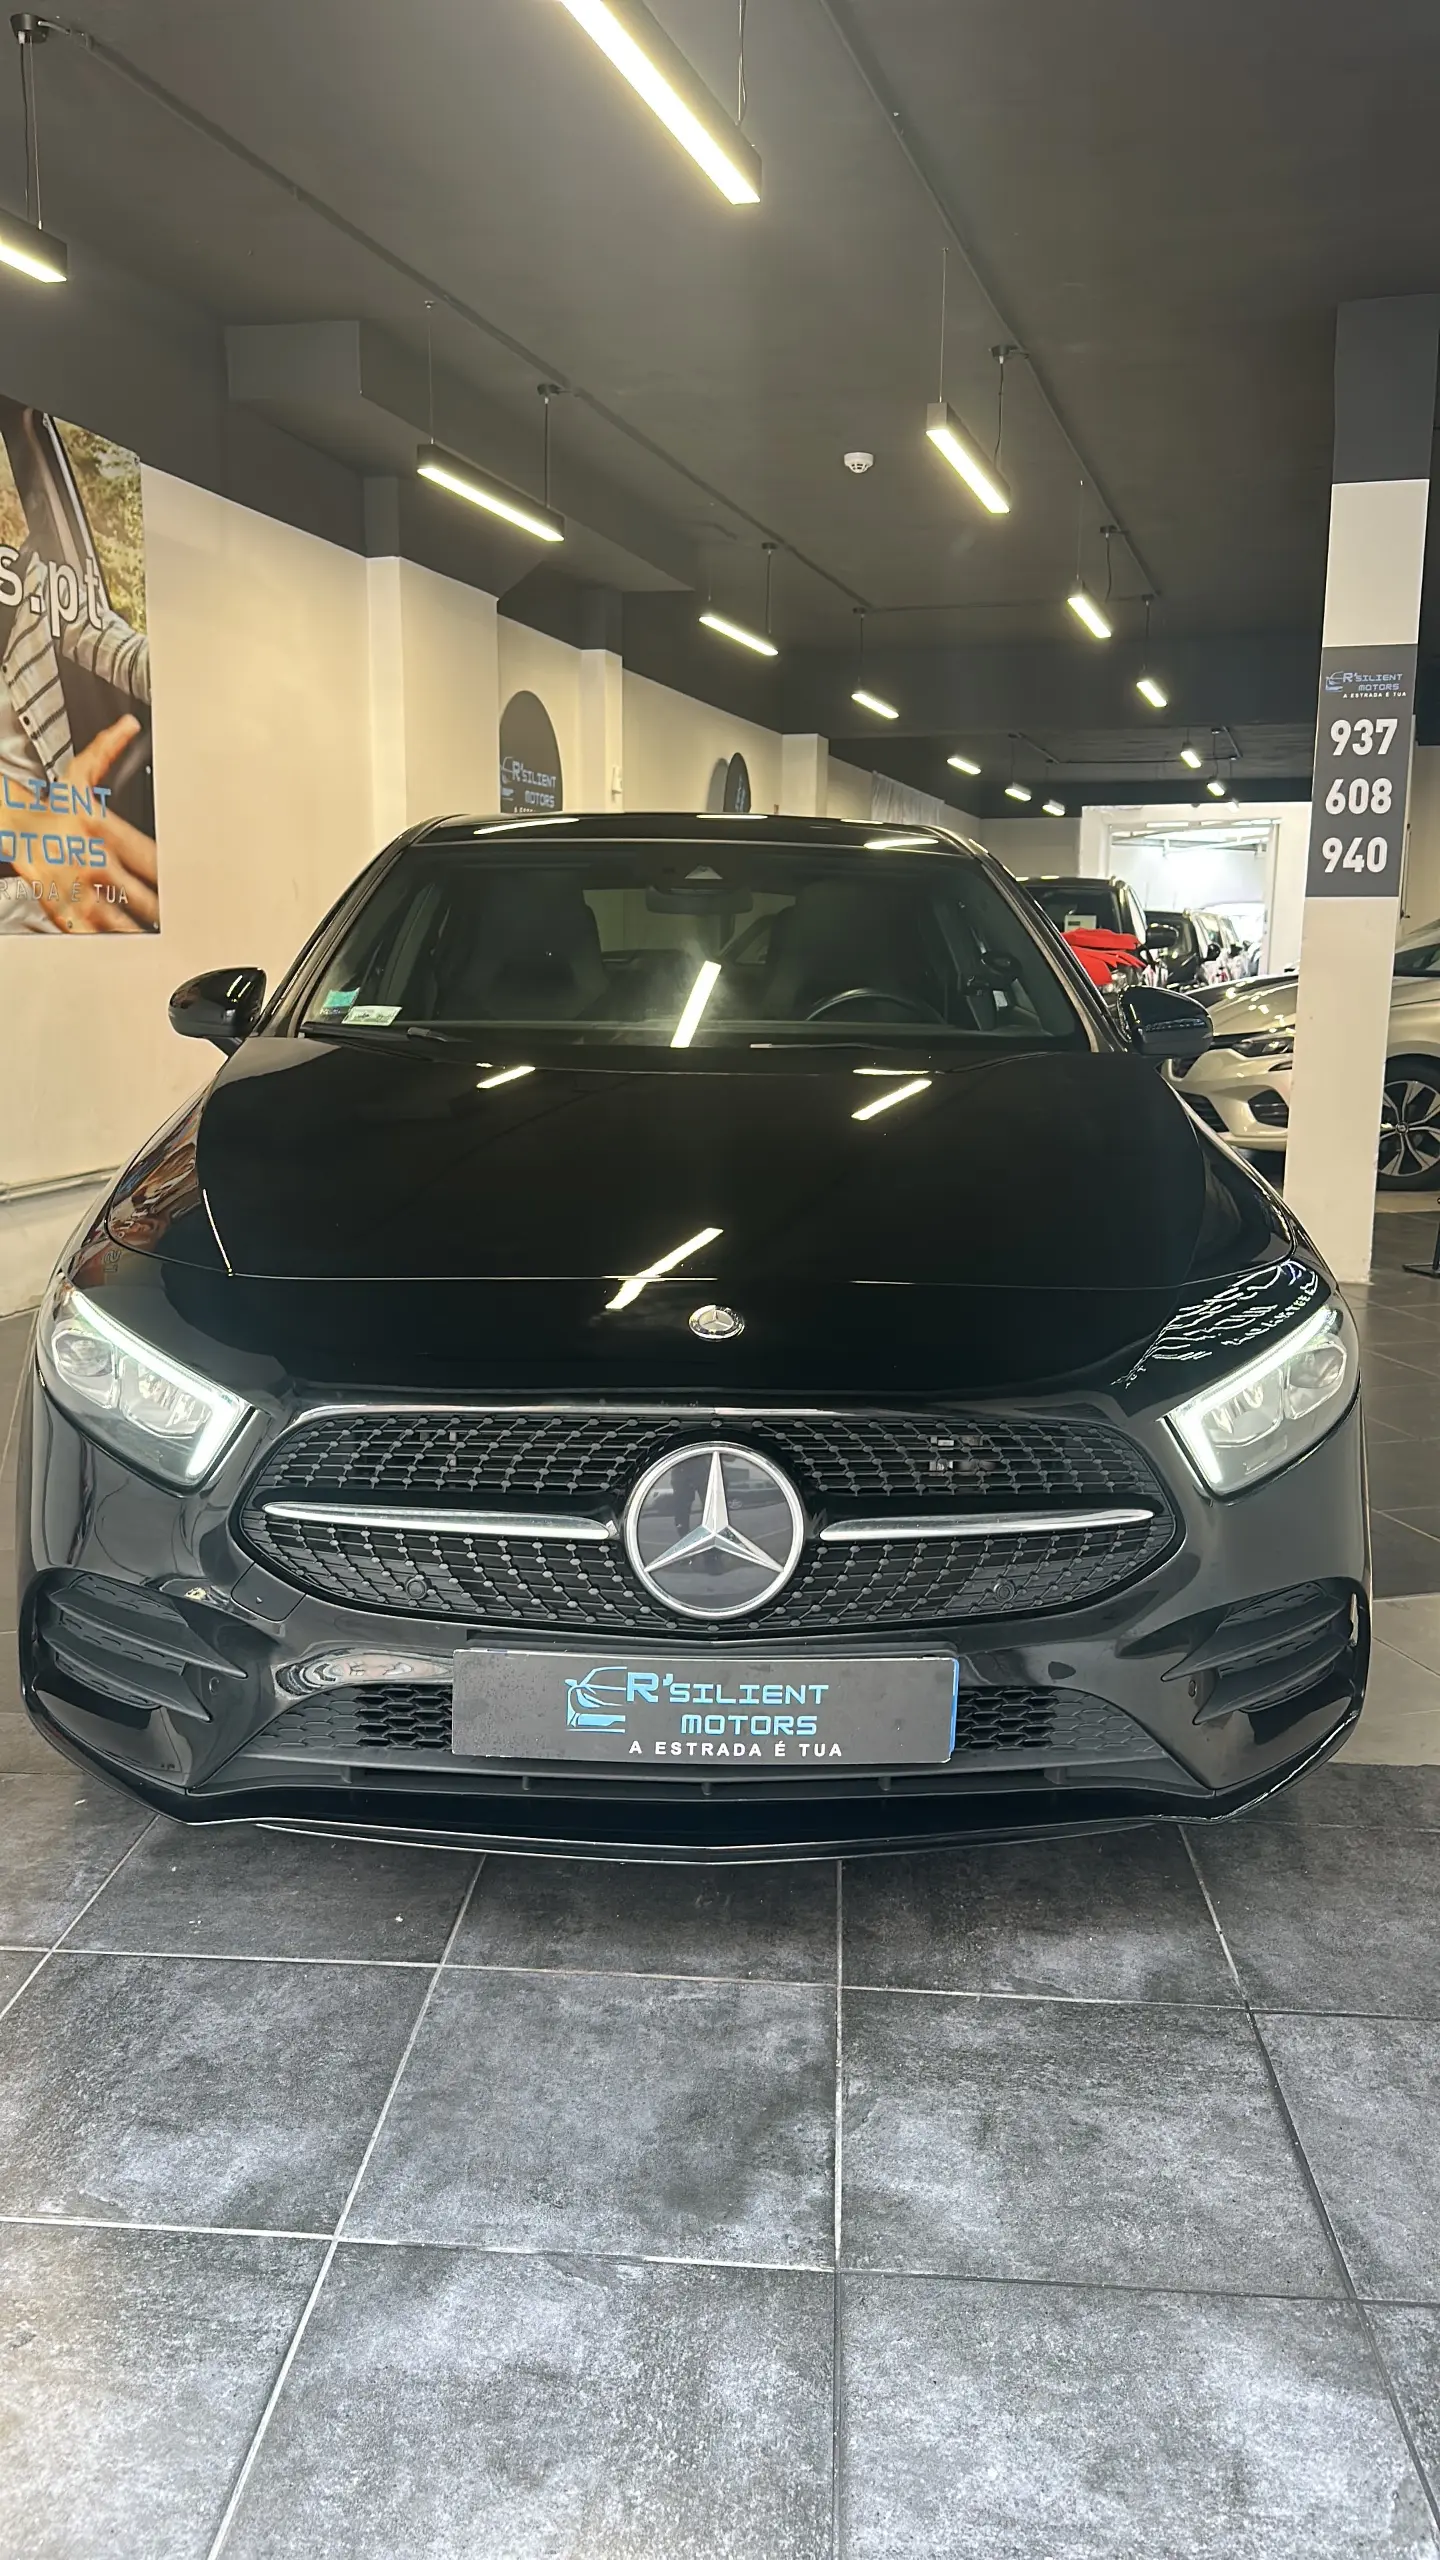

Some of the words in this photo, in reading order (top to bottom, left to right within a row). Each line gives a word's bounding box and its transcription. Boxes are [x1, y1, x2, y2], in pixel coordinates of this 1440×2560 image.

[1343, 672, 1403, 682] R'SILIENT
[1358, 683, 1400, 691] MOTORS
[1330, 719, 1398, 755] 937
[1325, 778, 1392, 814] 608
[1322, 837, 1388, 873] 940
[94, 883, 129, 904] TUA
[626, 1672, 829, 1704] R'SILIENT
[681, 1715, 818, 1736] MOTORS
[629, 1741, 642, 1754] A
[655, 1742, 762, 1757] ESTRADA
[774, 1741, 786, 1757] É
[799, 1744, 842, 1757] TUA
